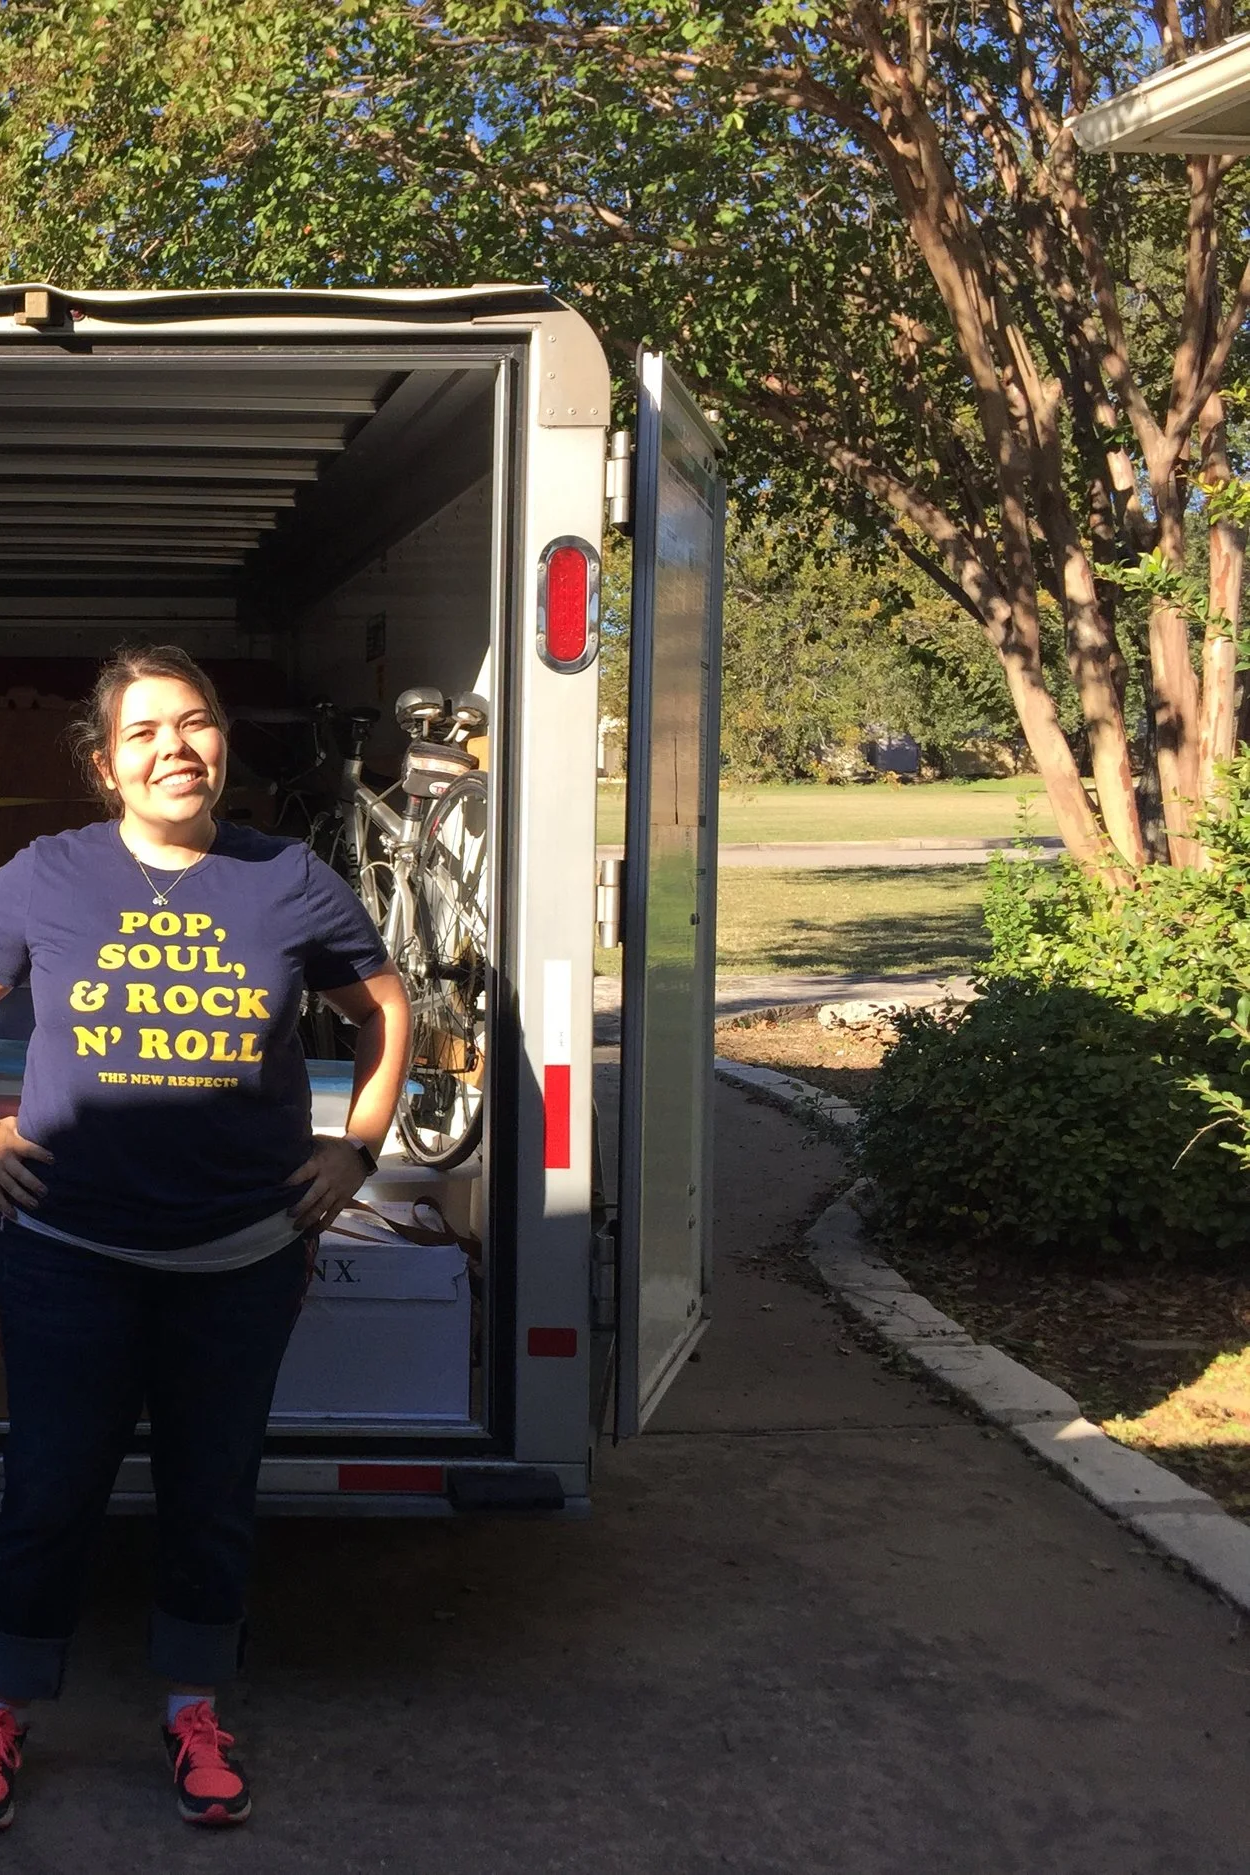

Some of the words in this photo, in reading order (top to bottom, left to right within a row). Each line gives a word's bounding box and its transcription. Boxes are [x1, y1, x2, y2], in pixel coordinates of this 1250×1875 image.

[119, 911, 227, 942] POP,
[97, 943, 246, 980] SOUL,
[69, 980, 109, 1012] &
[125, 983, 271, 1019] ROCK
[72, 1025, 123, 1057] N'
[138, 1028, 263, 1062] ROLL
[98, 1071, 128, 1084] THE
[130, 1073, 163, 1086] NEW
[167, 1074, 239, 1088] RESPECTS
